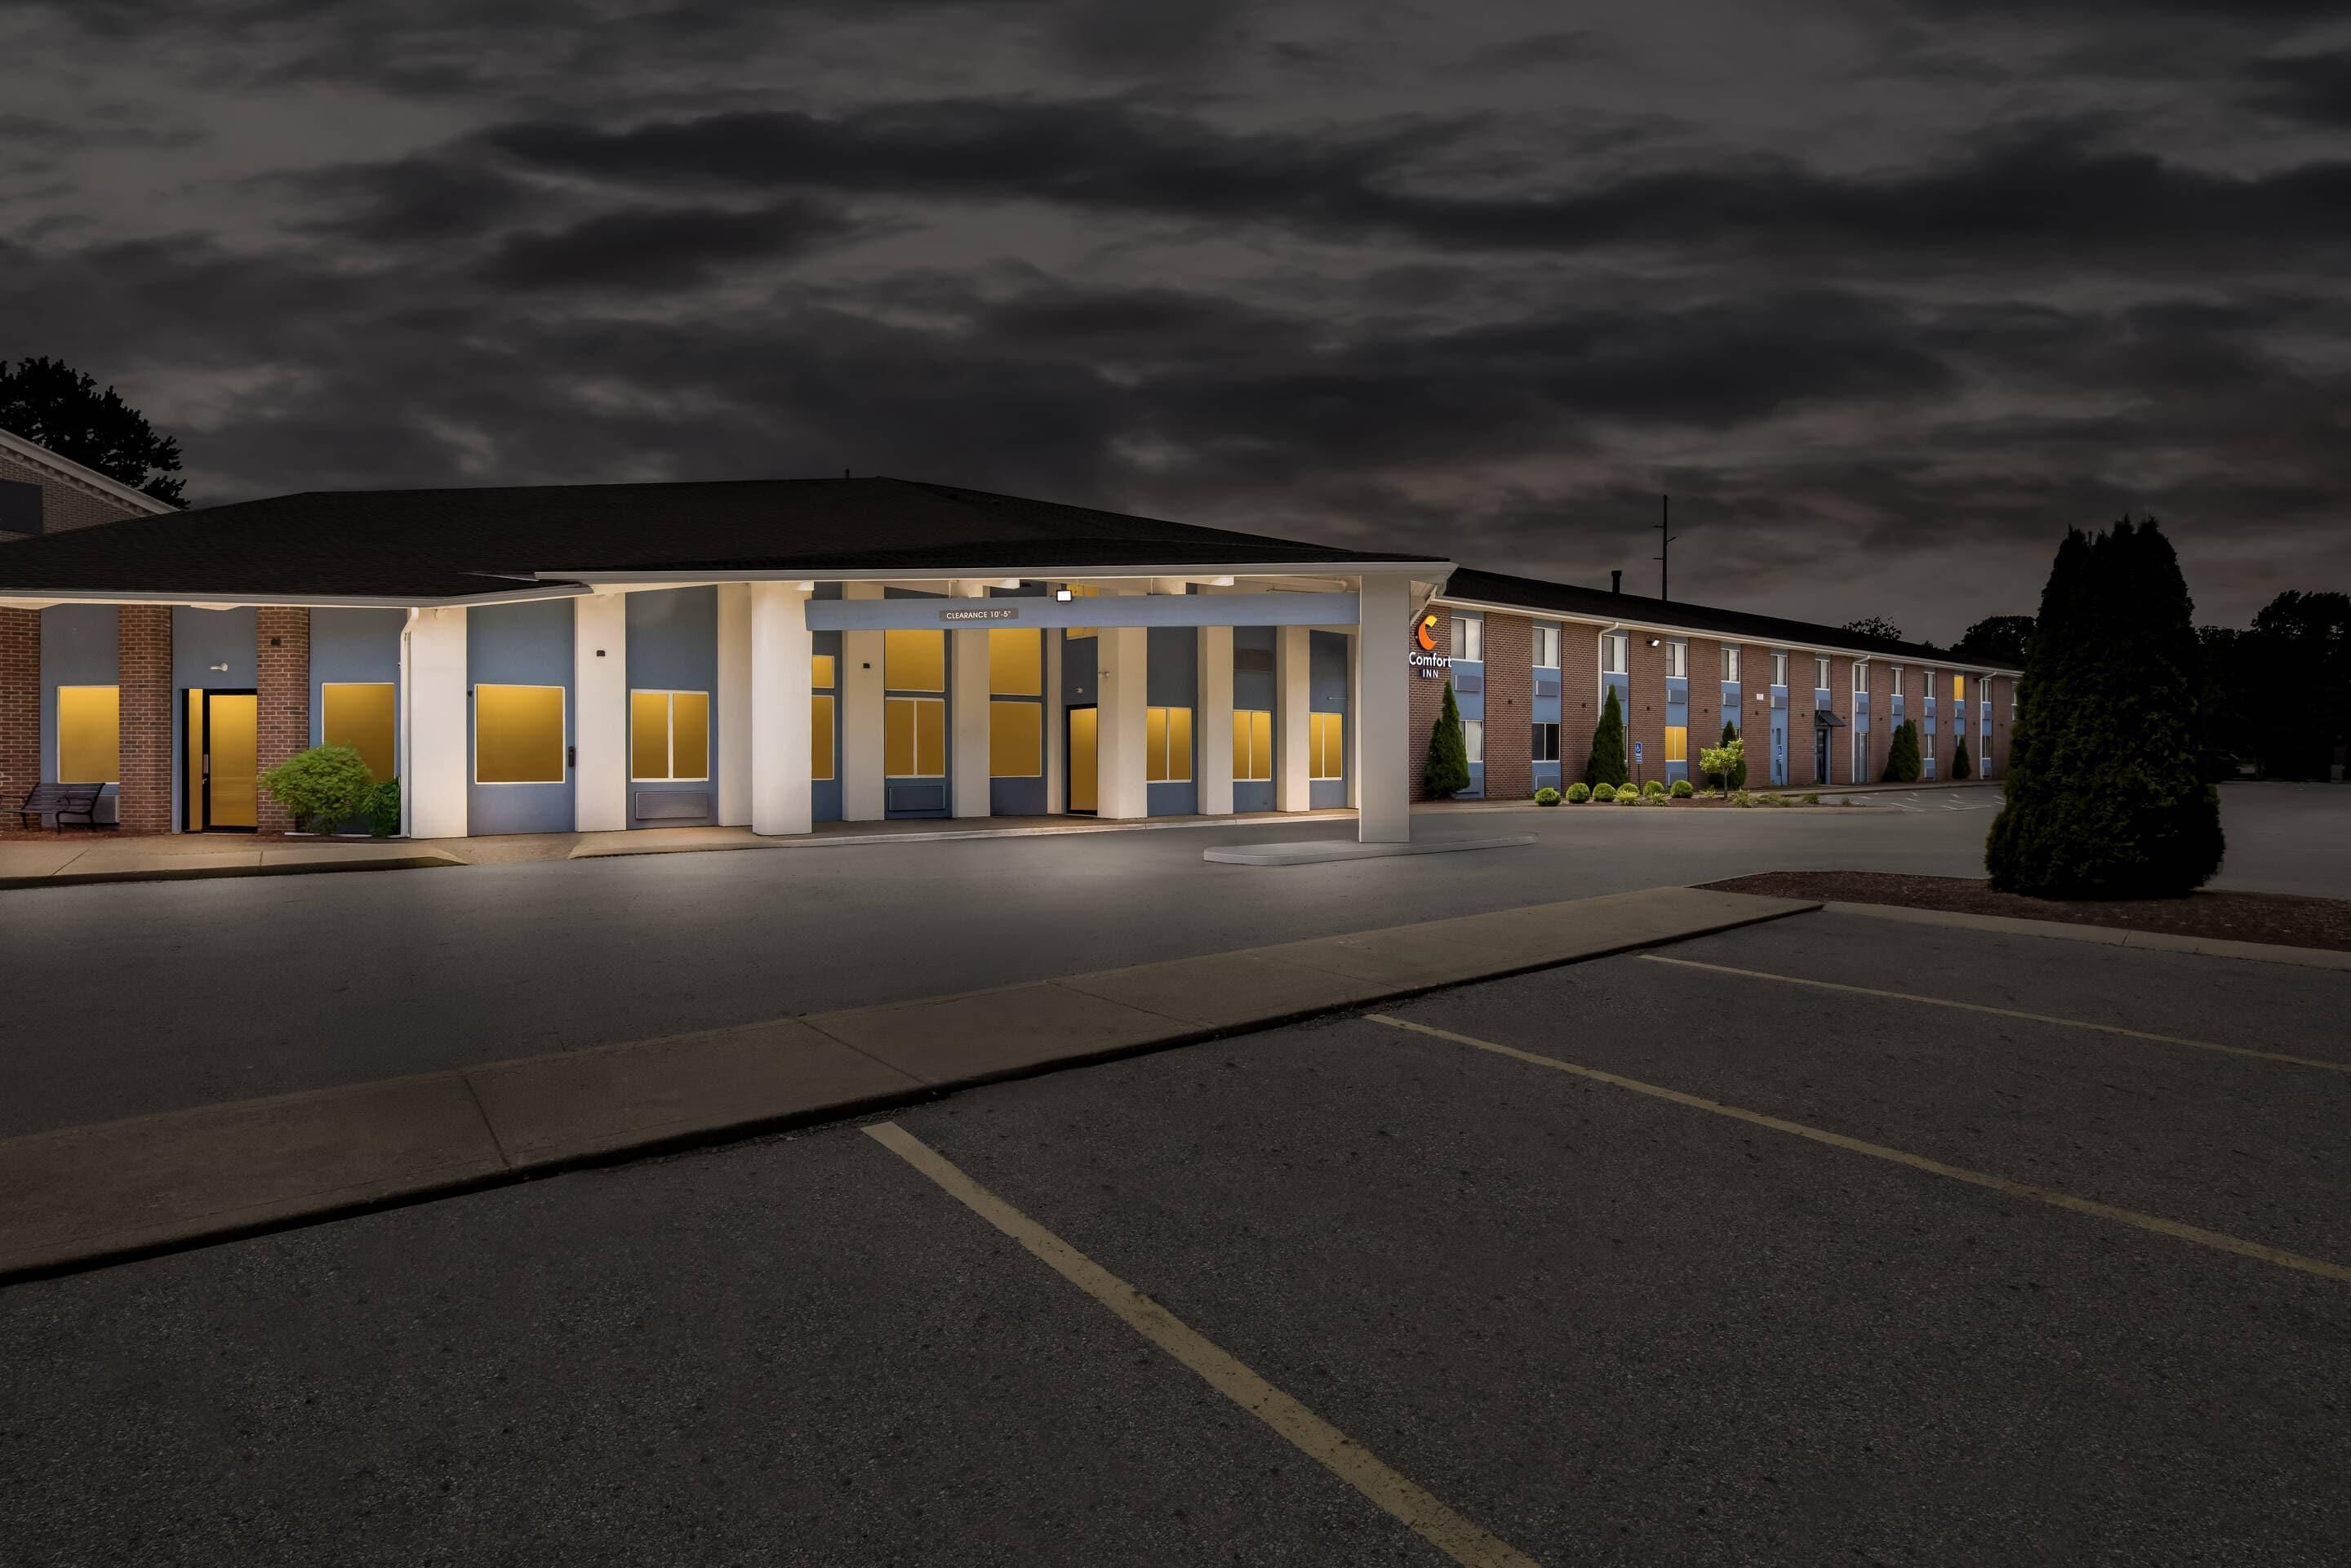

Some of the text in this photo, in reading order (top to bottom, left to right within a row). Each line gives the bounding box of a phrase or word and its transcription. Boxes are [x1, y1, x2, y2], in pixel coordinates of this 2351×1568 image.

[946, 611, 988, 620] CLEARANCE
[1409, 651, 1451, 668] Comfort
[1422, 669, 1438, 678] INN
